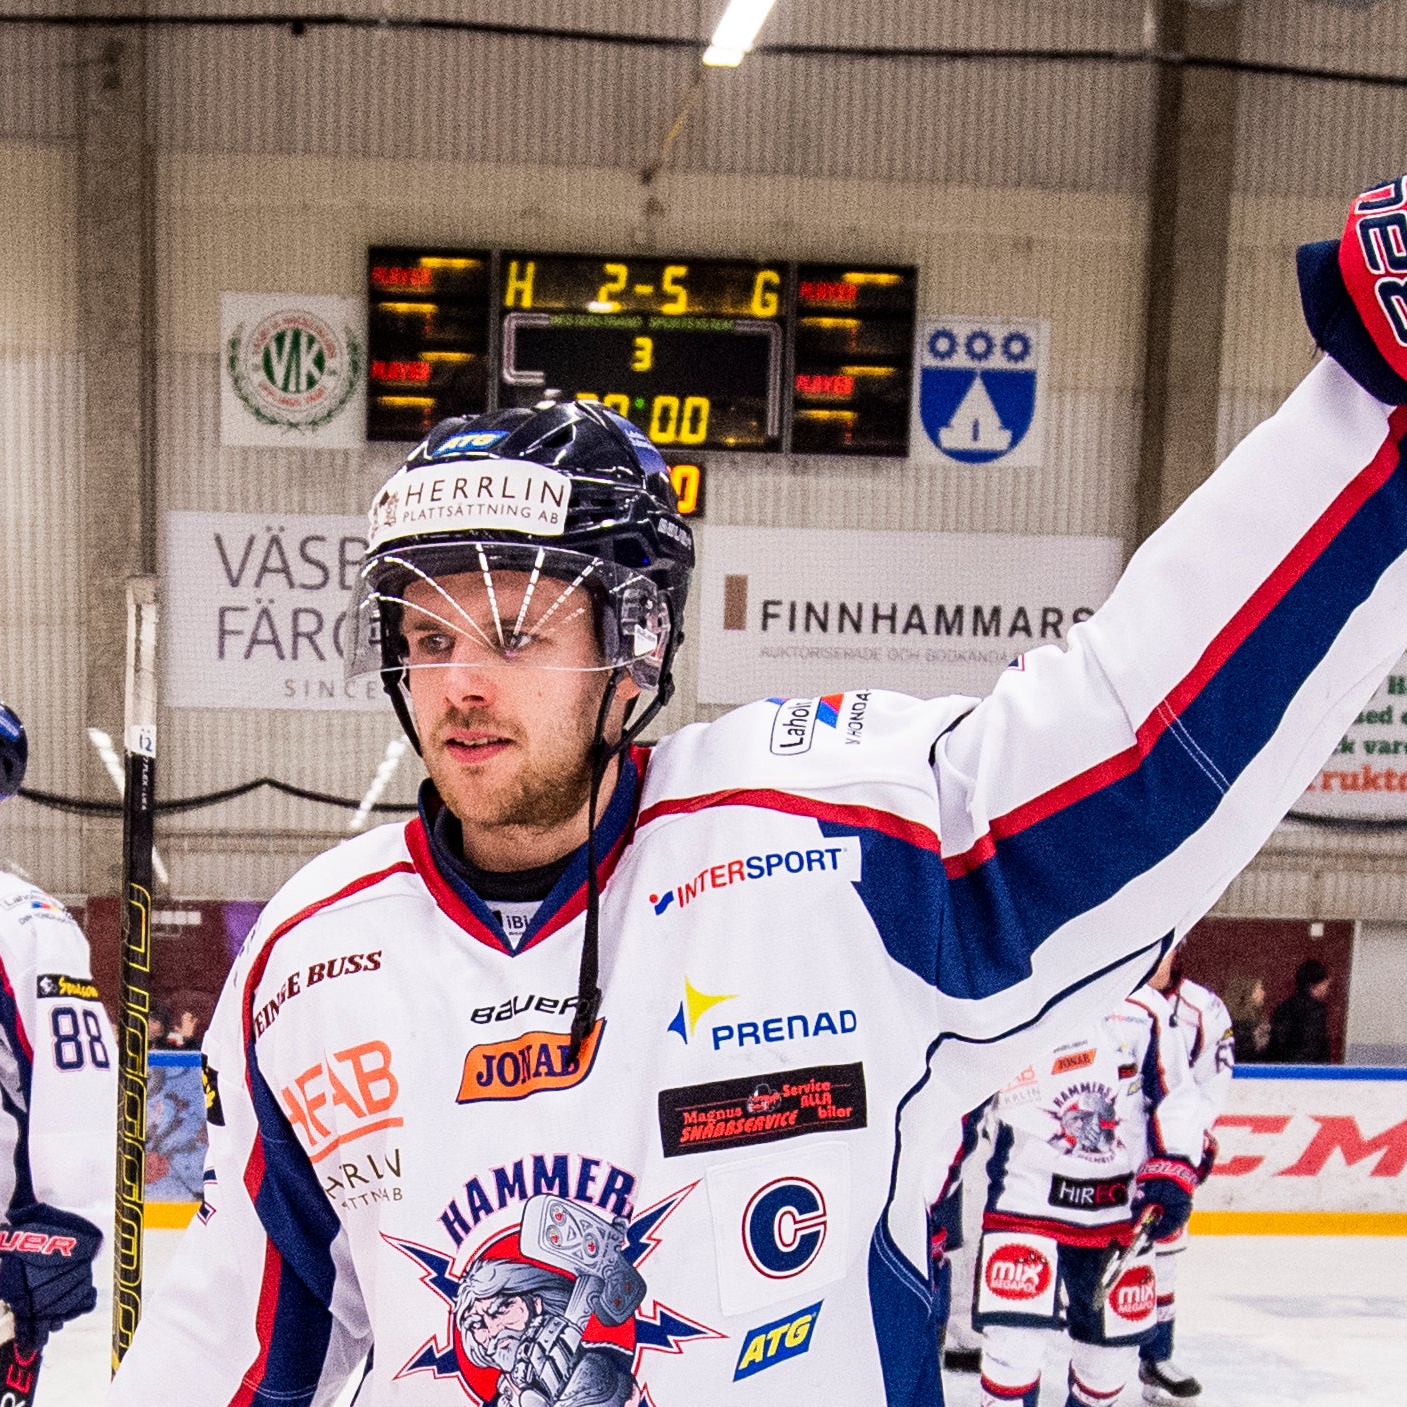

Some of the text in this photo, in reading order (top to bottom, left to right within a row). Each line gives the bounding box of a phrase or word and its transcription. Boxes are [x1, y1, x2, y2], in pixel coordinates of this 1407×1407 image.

[505, 261, 780, 318] H 2-5 G
[631, 336, 653, 372] 3
[576, 393, 710, 443] 0:00
[404, 476, 565, 508] HERRLIN
[537, 510, 559, 525] AB
[213, 525, 370, 591] VÄSB
[284, 678, 377, 699] SINCE
[676, 848, 844, 908] INTERSPORT
[306, 950, 383, 988] BUSS
[49, 1003, 111, 1074] 88
[712, 1008, 858, 1051] PRENAD
[782, 1078, 831, 1098] Service
[800, 1092, 832, 1108] ALLA
[682, 1107, 742, 1125] Magnus
[437, 1153, 637, 1251] HAMMER
[740, 1175, 828, 1281] C
[992, 1261, 1043, 1285] mix
[737, 1315, 811, 1372] ATG
